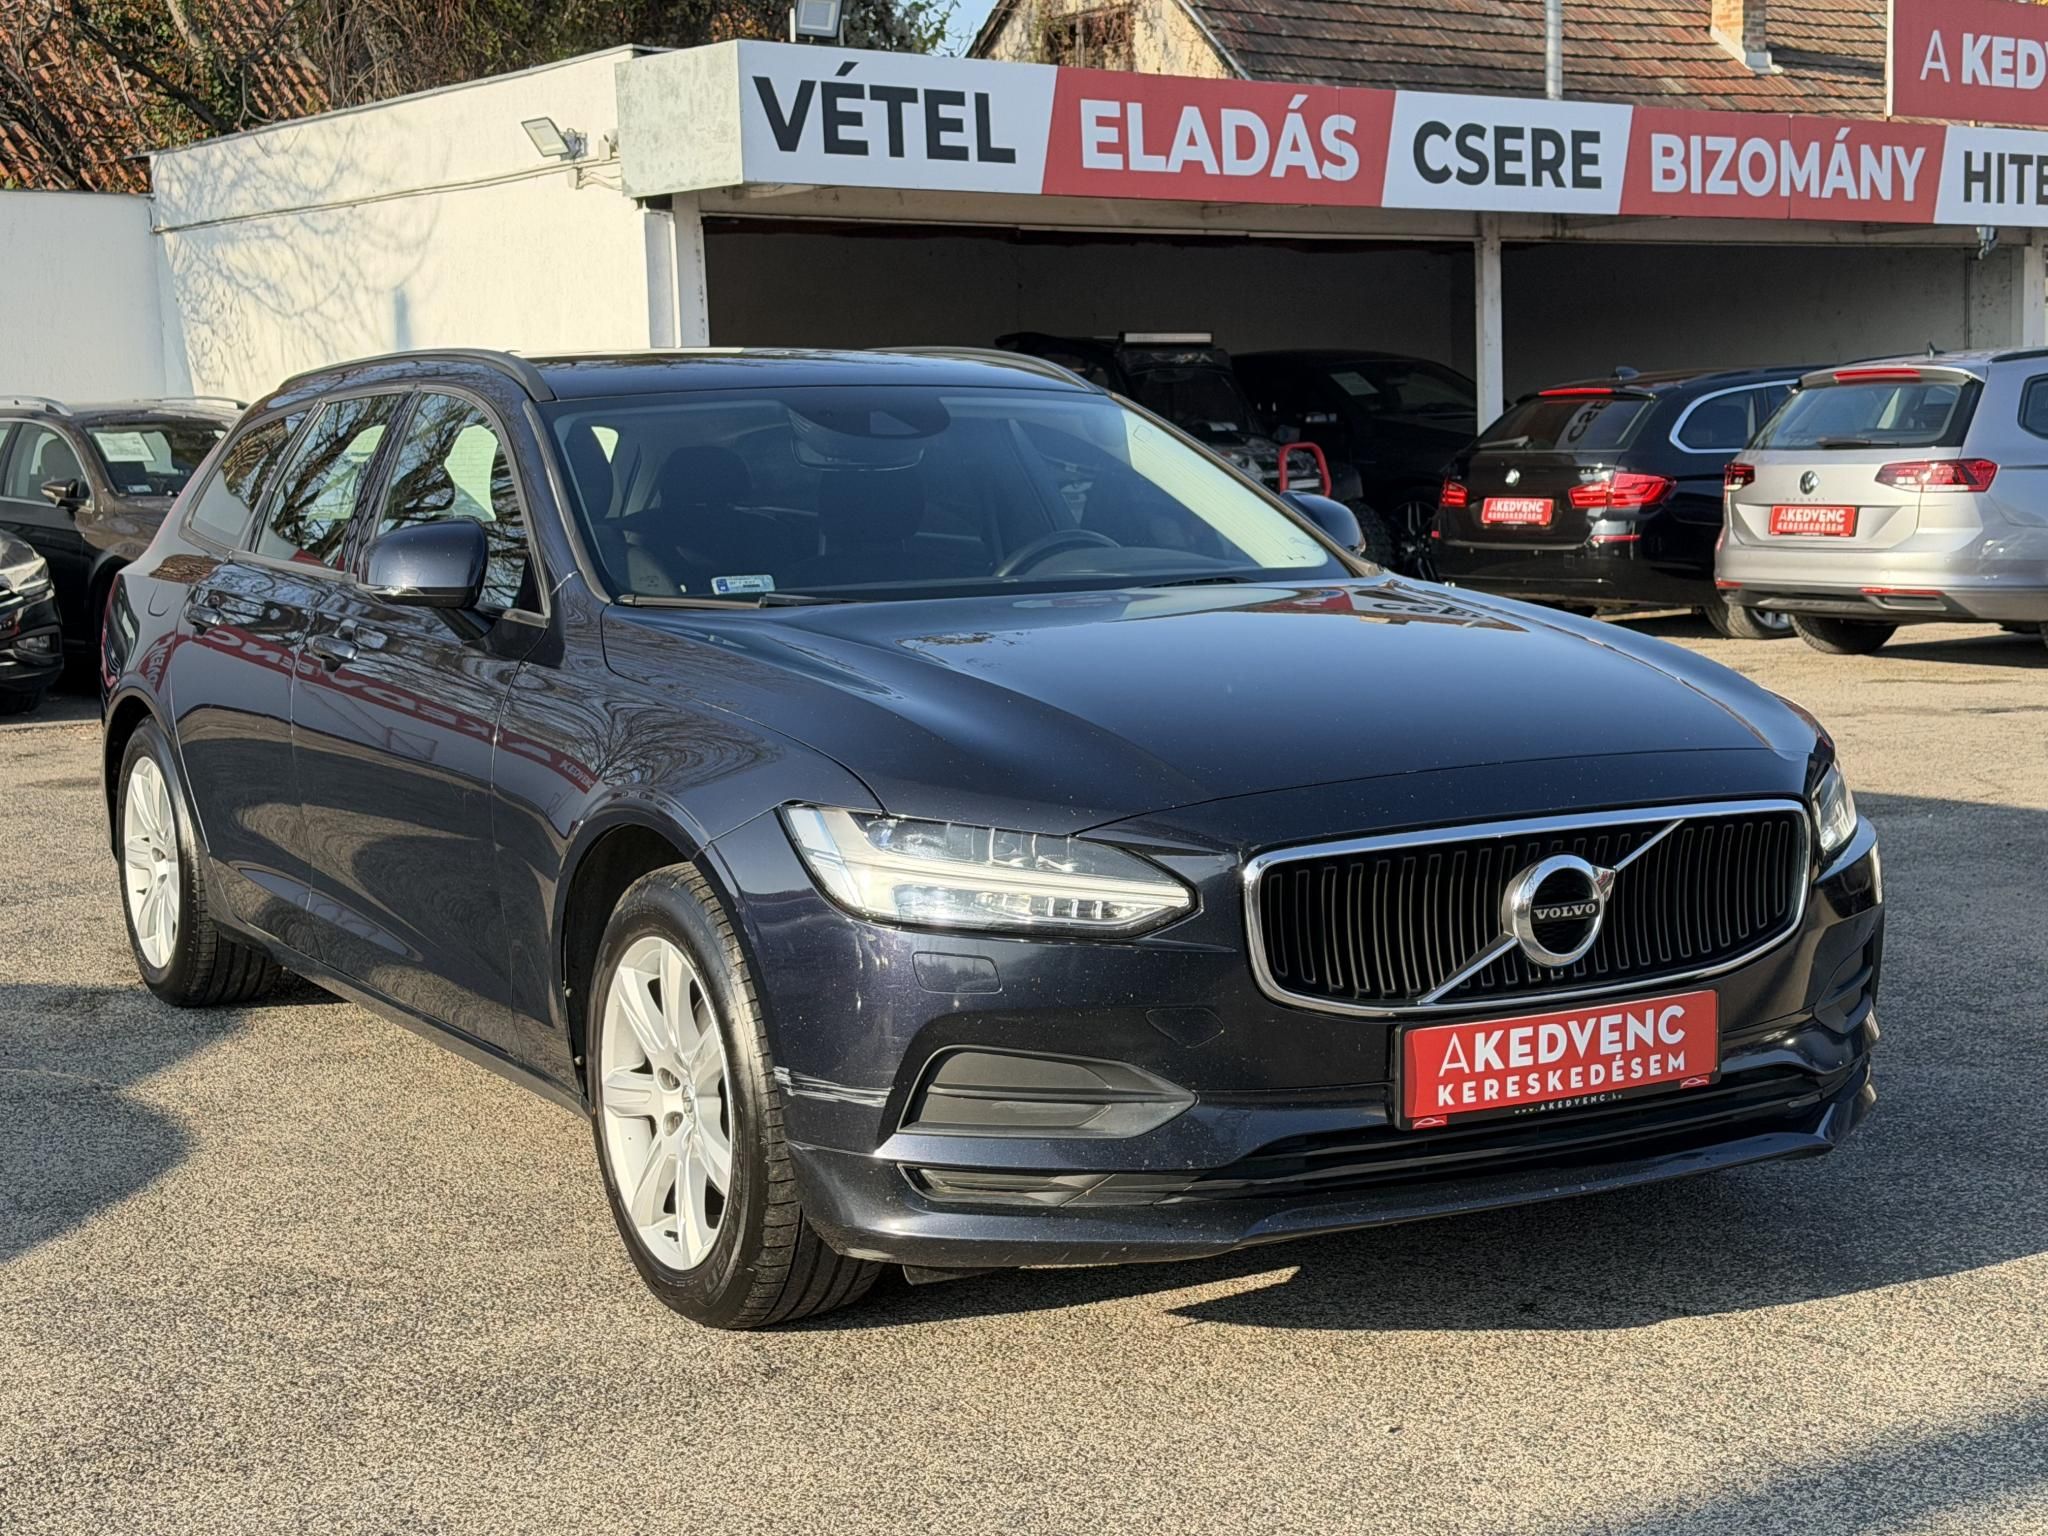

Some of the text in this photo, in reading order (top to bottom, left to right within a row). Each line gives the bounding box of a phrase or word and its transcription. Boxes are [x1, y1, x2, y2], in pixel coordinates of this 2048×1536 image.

[1919, 29, 2048, 90] A KED
[752, 61, 1017, 165] VÉTEL
[1080, 94, 1360, 182] ELADÁS
[1413, 120, 1603, 190] CSERE
[1651, 128, 1926, 202] BIZOMÁNY
[1533, 903, 1596, 920] VOLVO
[1437, 1051, 1686, 1107] KERESKEDÉSEM
